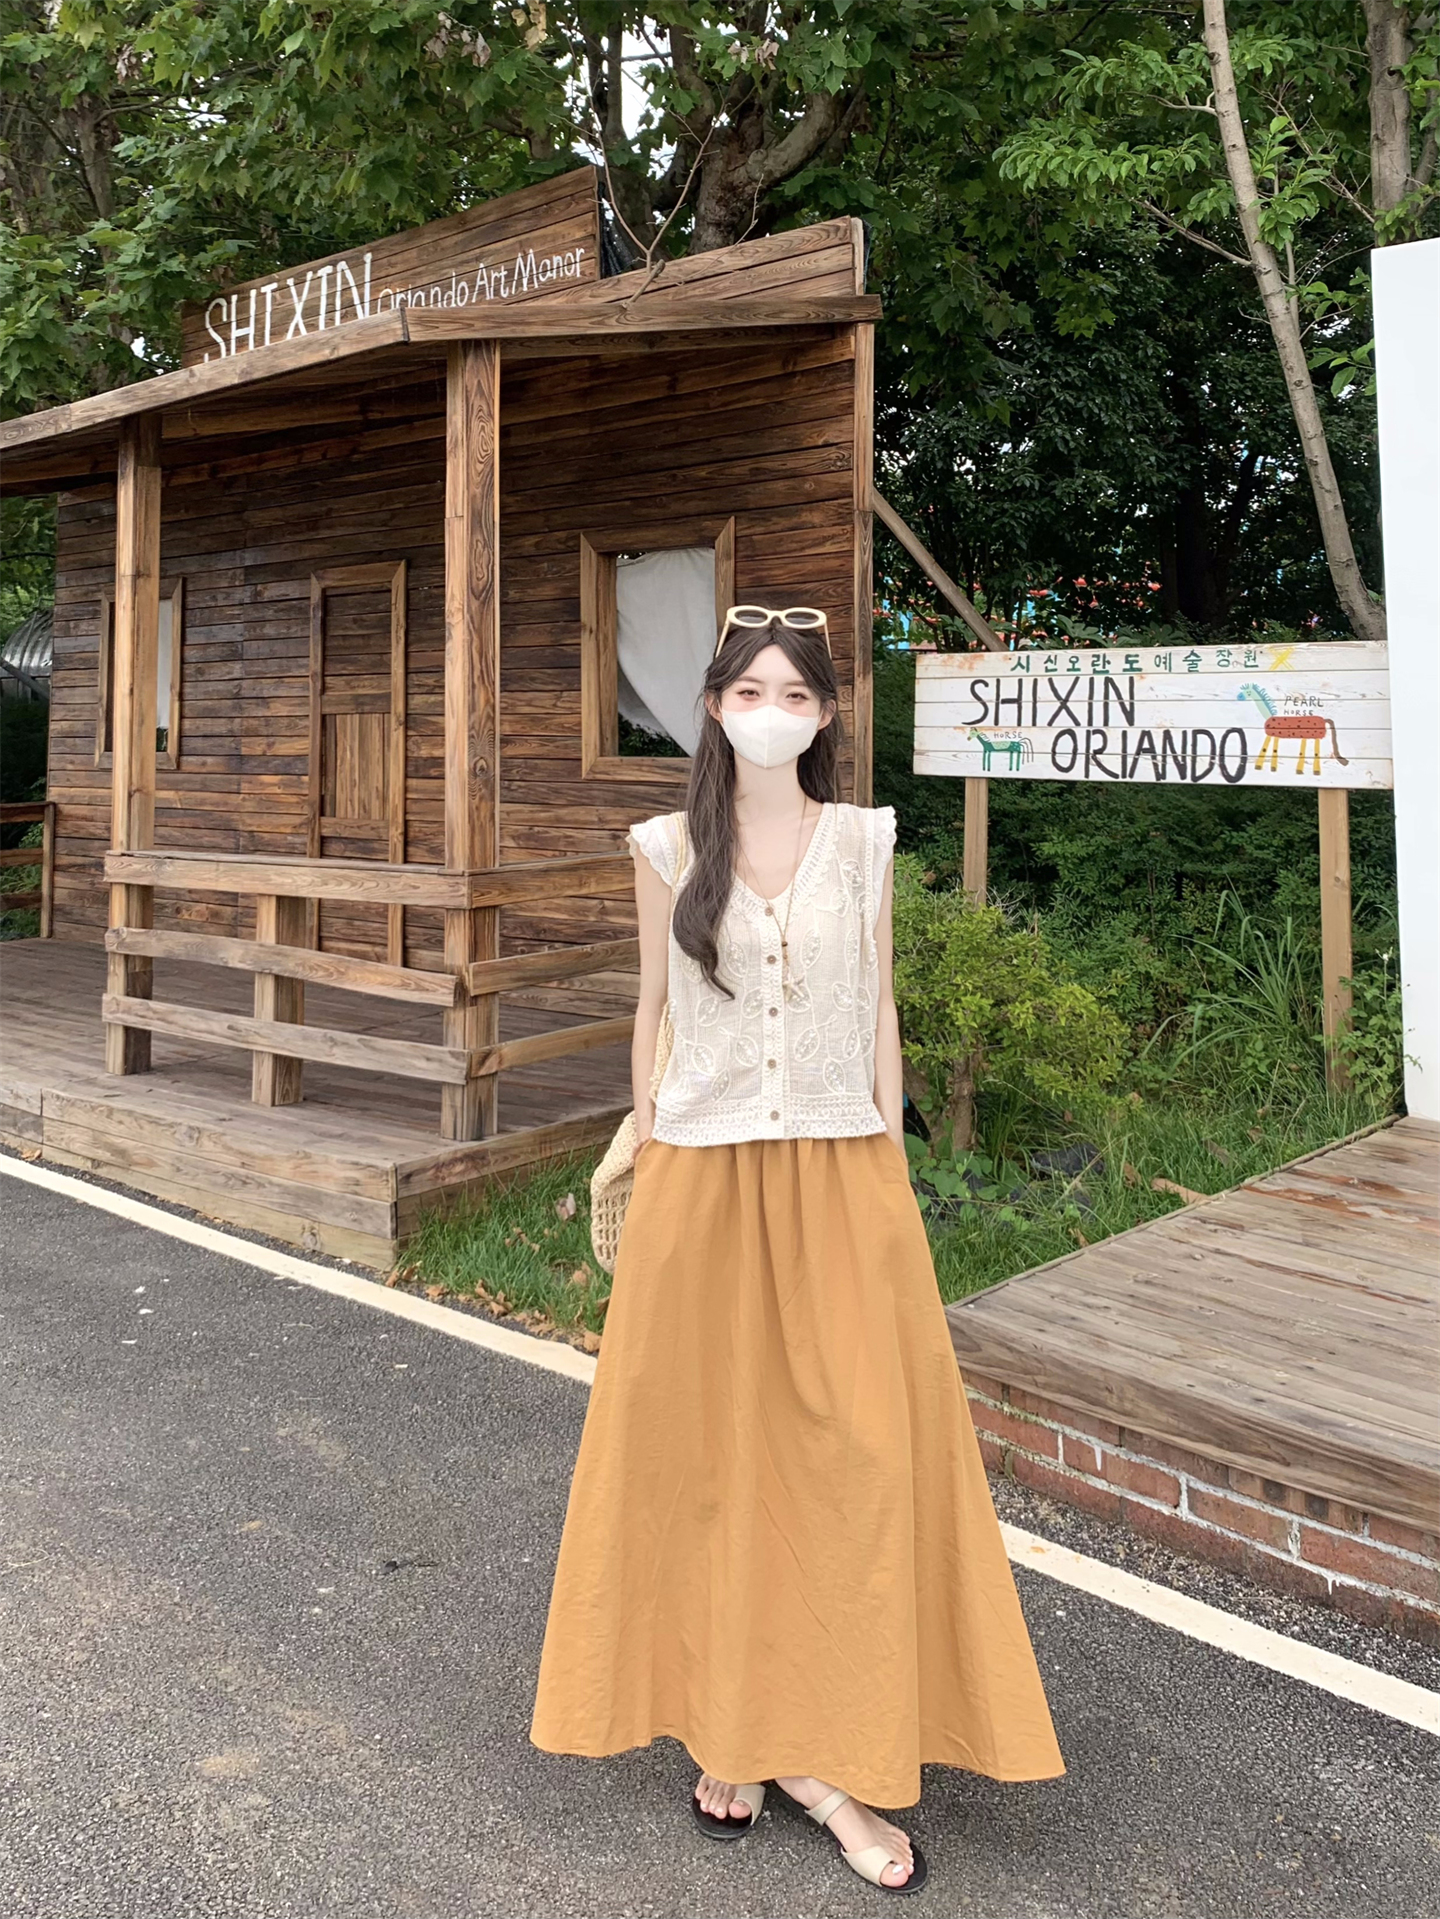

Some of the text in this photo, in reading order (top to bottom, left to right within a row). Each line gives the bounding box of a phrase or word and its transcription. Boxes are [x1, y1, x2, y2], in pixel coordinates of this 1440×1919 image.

[204, 252, 373, 363] SHIXIN
[471, 263, 510, 303] Art
[511, 248, 585, 295] Manor
[961, 676, 1135, 727] SHIXIN
[1283, 708, 1314, 717] HORSE
[1284, 695, 1324, 708] PEARL
[1051, 727, 1248, 783] ORIANDO
